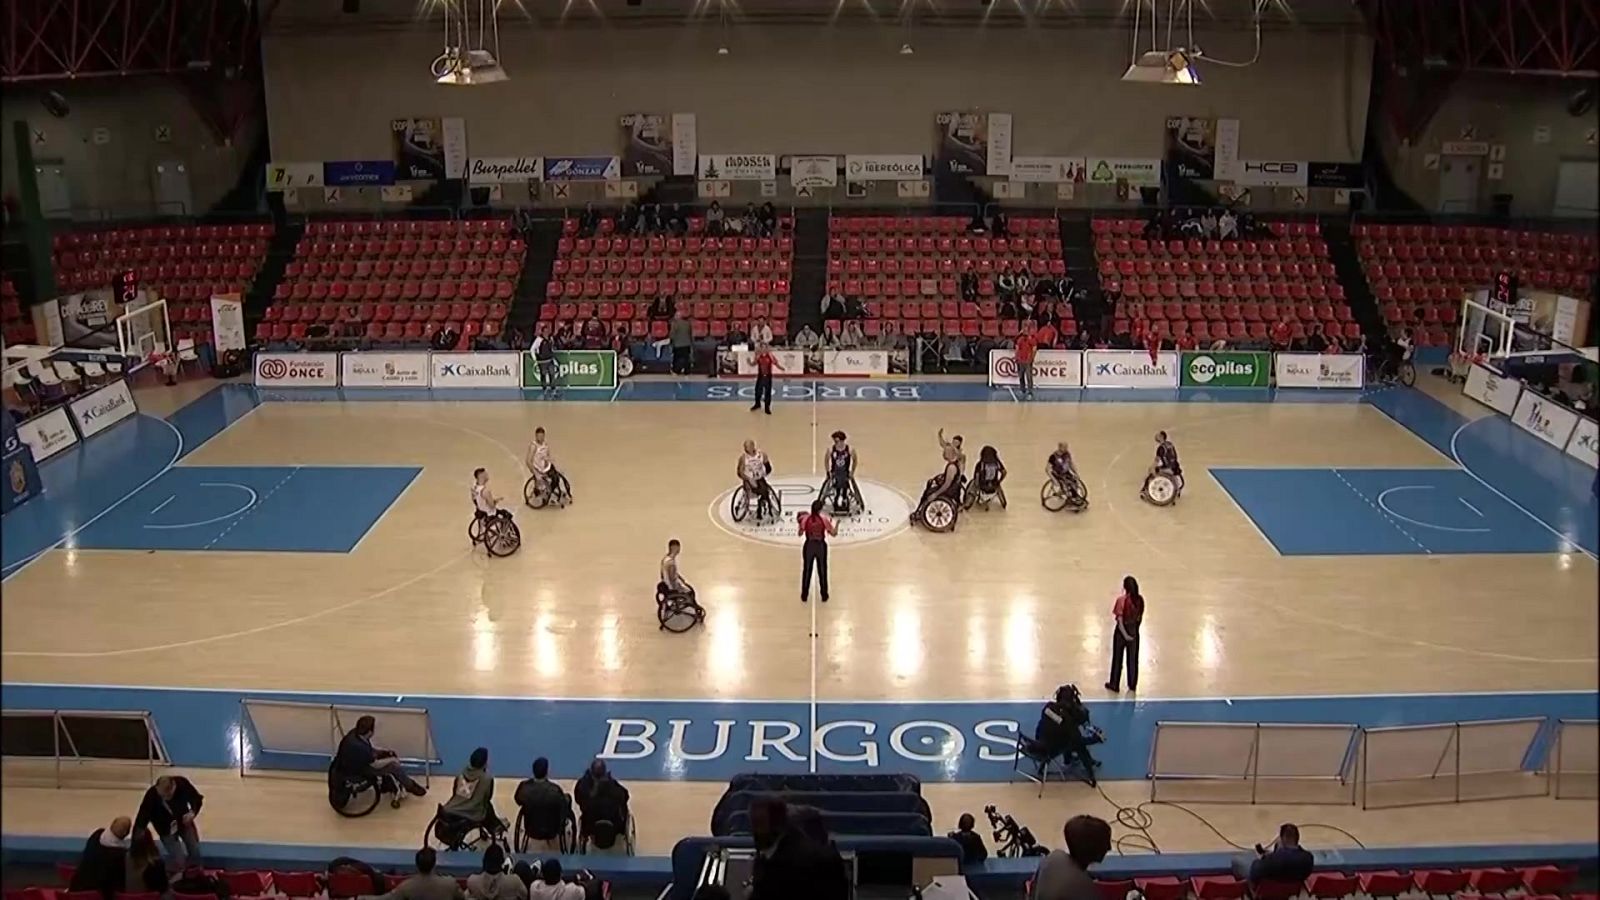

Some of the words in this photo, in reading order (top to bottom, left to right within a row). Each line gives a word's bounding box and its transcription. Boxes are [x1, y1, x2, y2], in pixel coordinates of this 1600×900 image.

[473, 158, 537, 180] Burpellet
[865, 162, 921, 172] IBEREÓLICA
[1245, 163, 1298, 173] HCB
[1033, 359, 1068, 367] undación
[289, 368, 325, 378] ONCE
[456, 364, 511, 377] CaixaBank
[1032, 368, 1067, 378] ONCE
[1113, 364, 1167, 377] CaixaBank
[1189, 361, 1253, 378] ecopilas
[595, 718, 1021, 767] BURGOS
